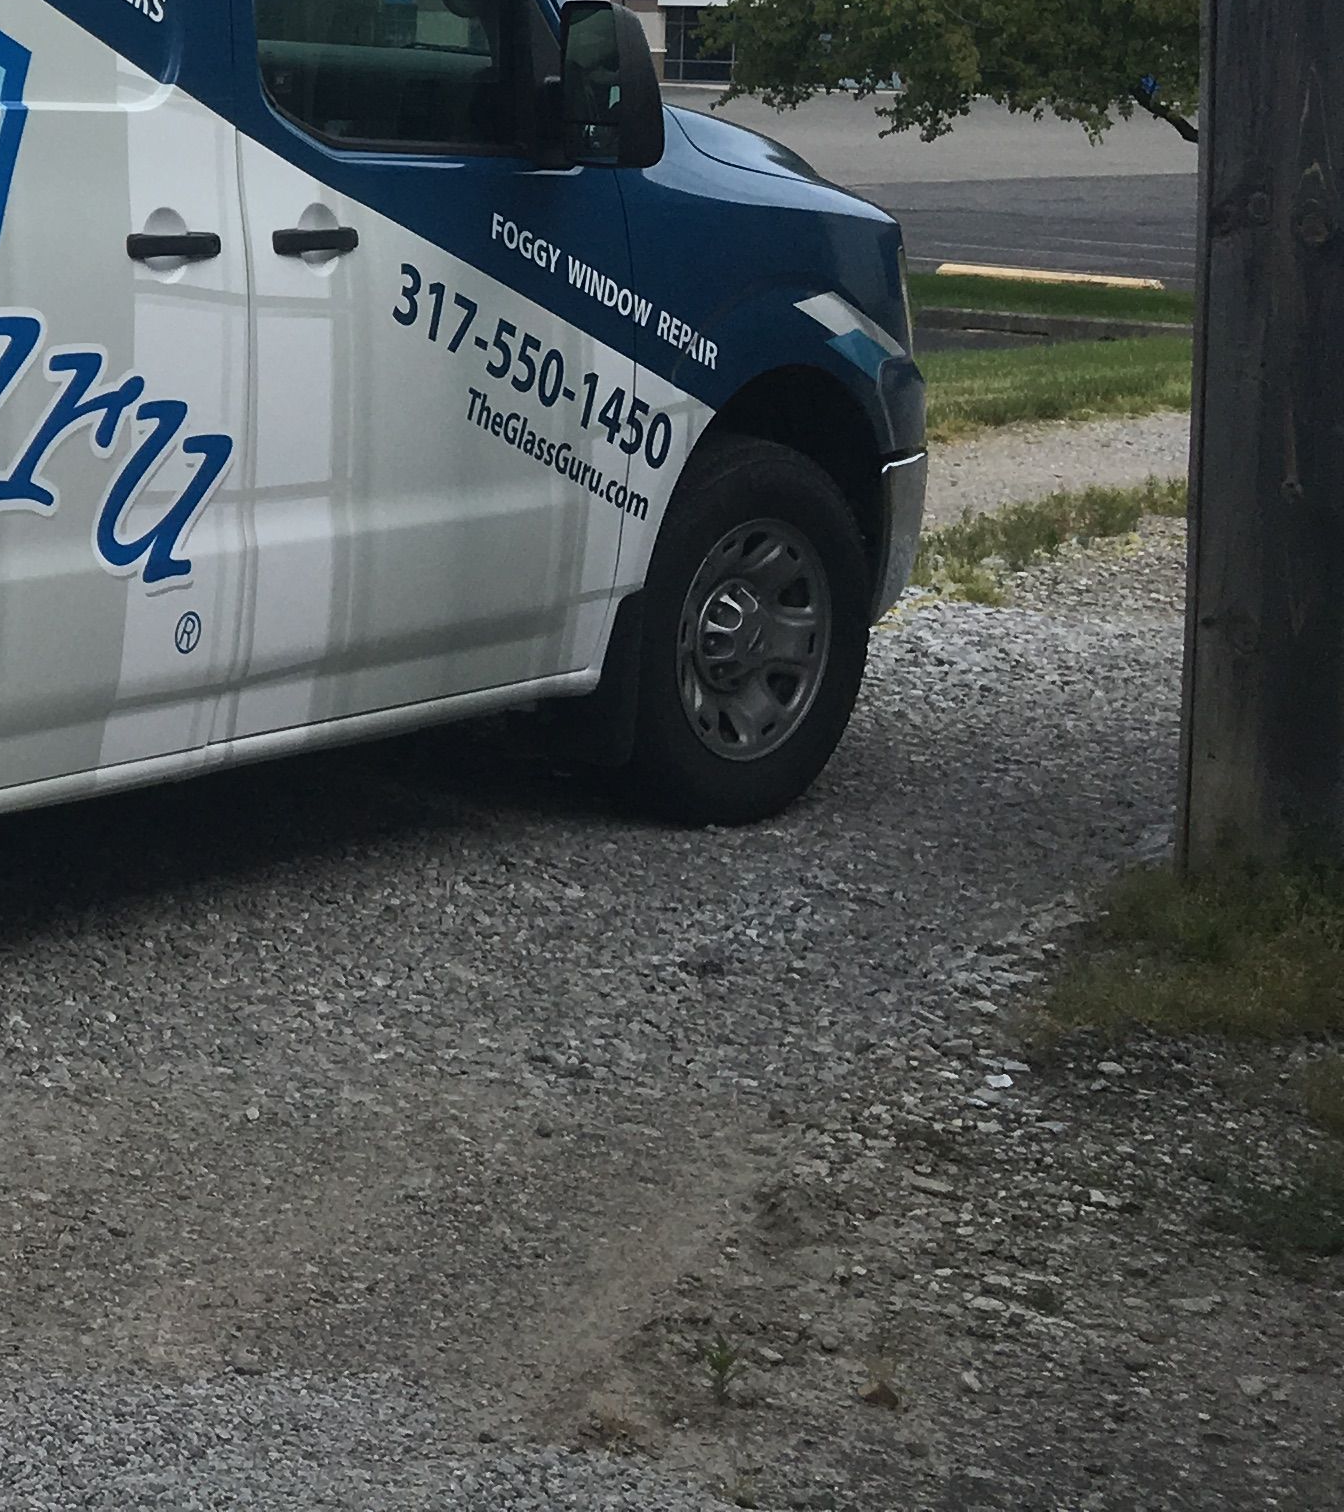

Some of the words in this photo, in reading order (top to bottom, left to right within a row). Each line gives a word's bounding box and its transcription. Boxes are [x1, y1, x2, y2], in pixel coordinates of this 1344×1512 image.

[391, 263, 672, 470] 317-550-1450
[491, 212, 562, 273] FOGGY
[567, 255, 653, 328] WINDOW
[657, 310, 719, 370] REPAIR
[465, 386, 649, 522] TheGlassGuru.com
